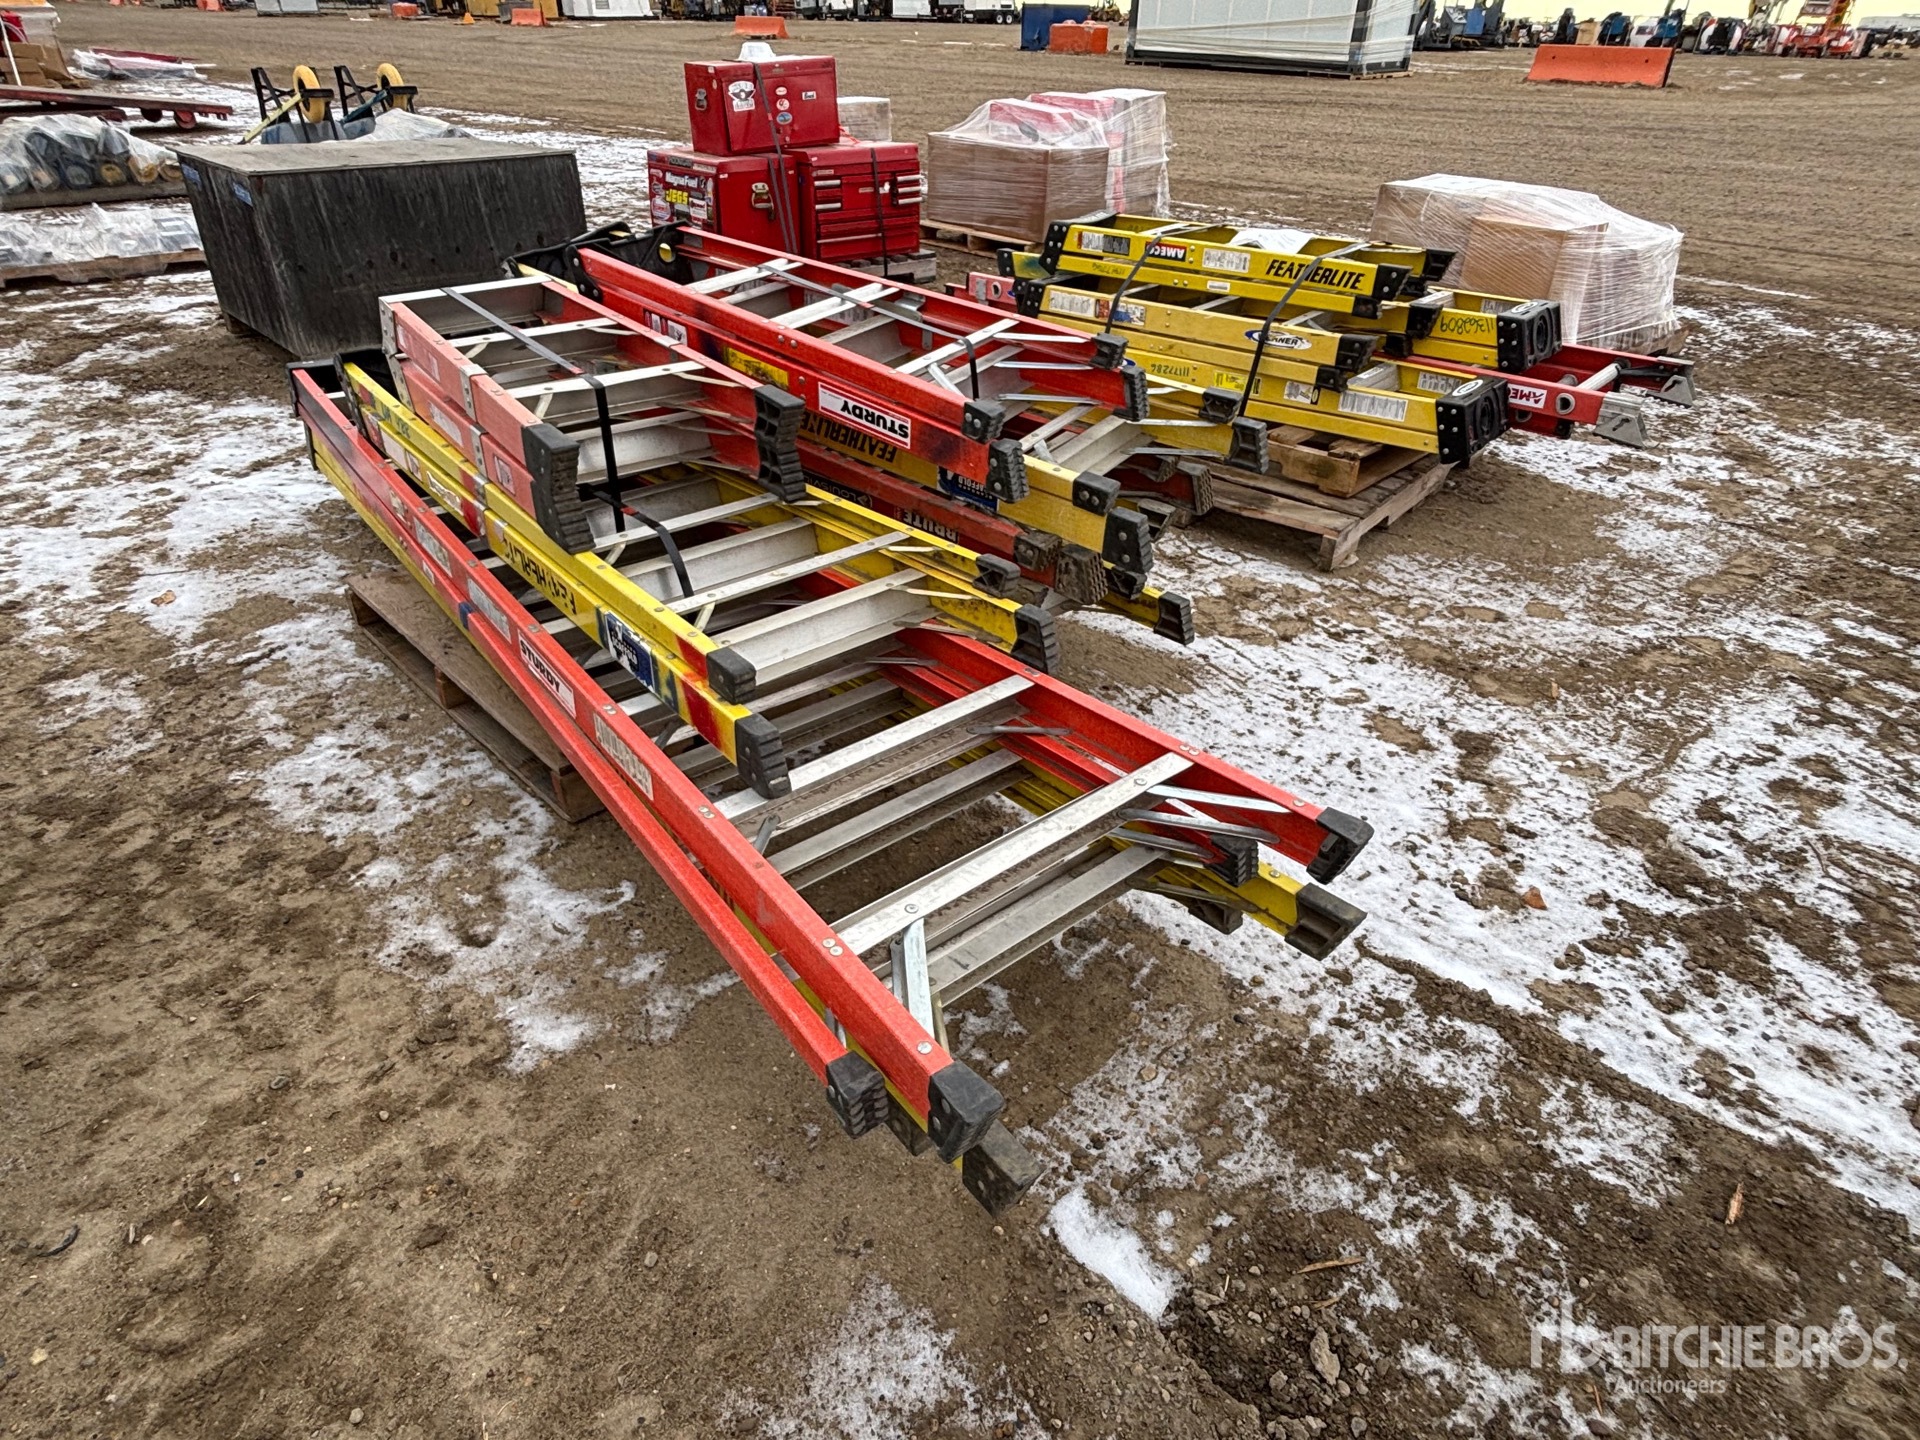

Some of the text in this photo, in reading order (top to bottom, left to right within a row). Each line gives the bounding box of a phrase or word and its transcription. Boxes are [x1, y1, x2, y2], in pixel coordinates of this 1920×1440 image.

[666, 189, 688, 205] JEGS
[840, 399, 910, 439] STURDY
[520, 639, 560, 693] STURDY
